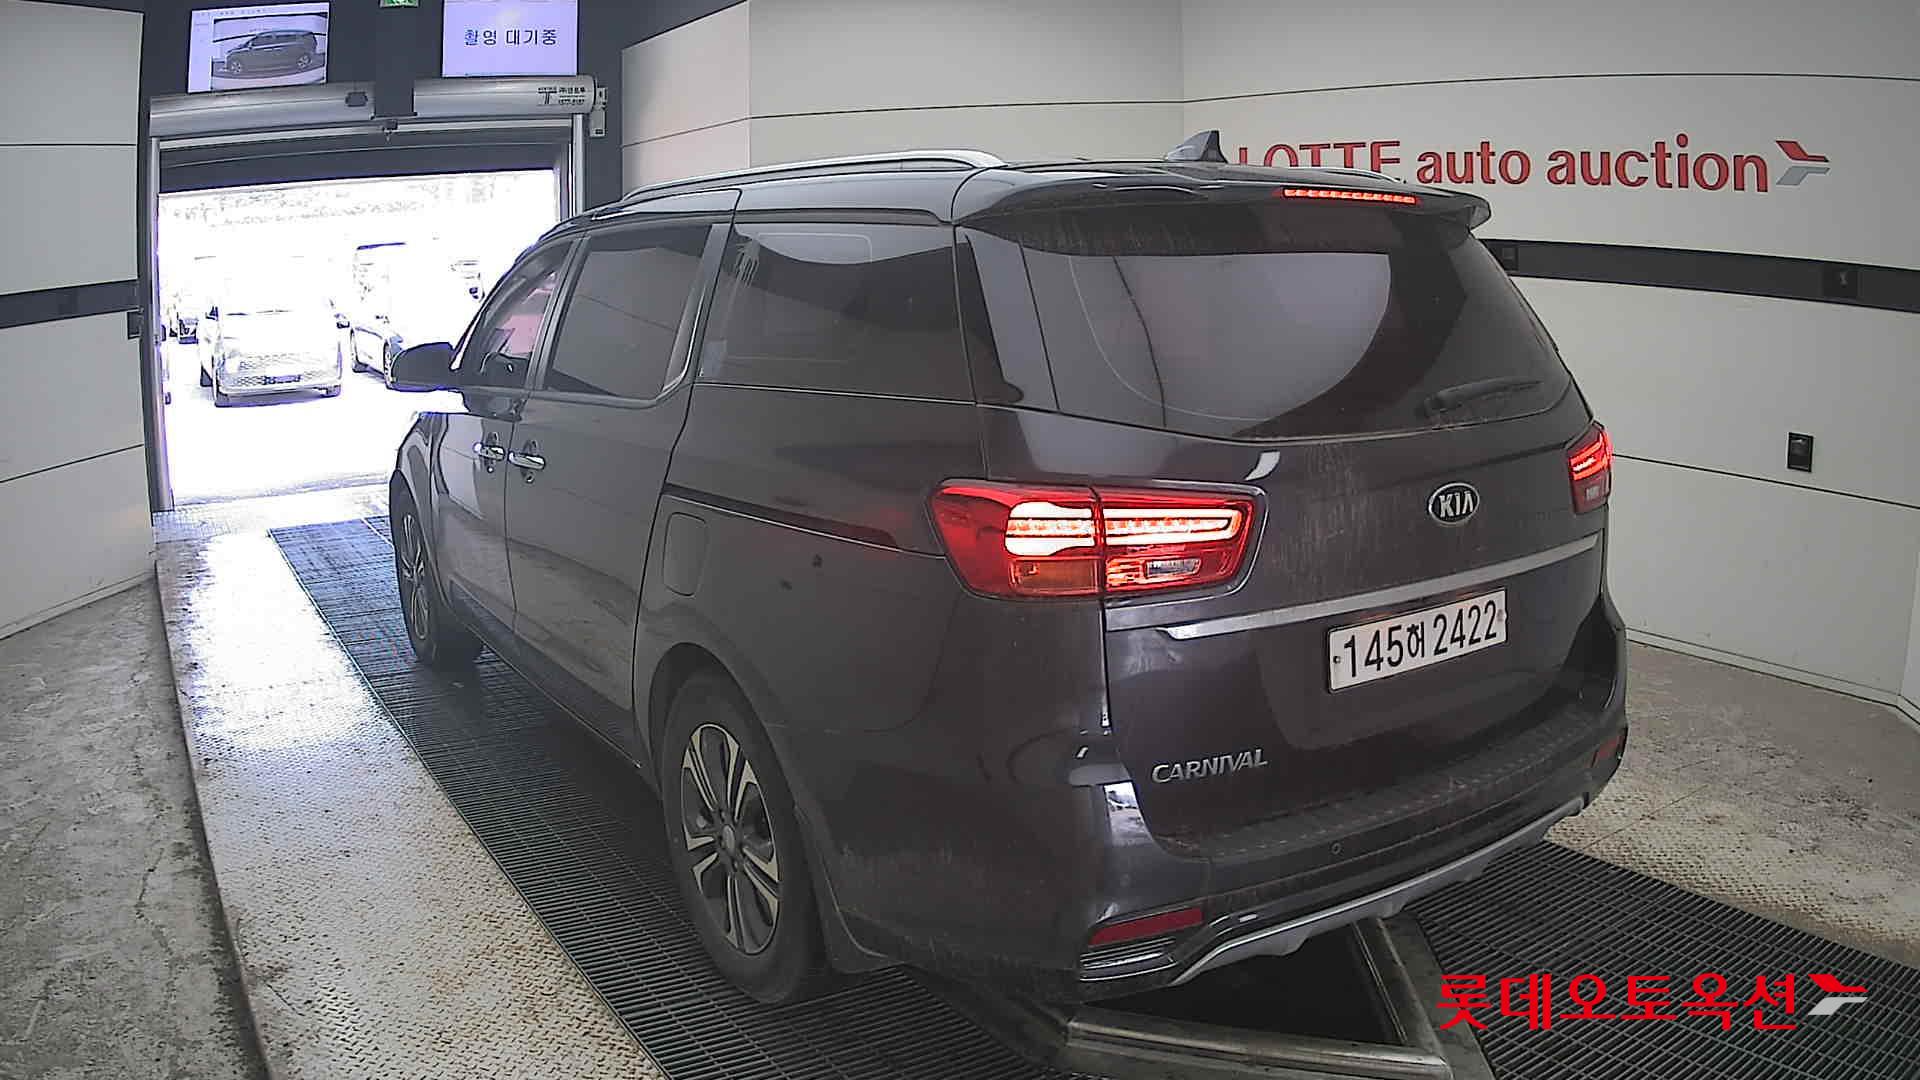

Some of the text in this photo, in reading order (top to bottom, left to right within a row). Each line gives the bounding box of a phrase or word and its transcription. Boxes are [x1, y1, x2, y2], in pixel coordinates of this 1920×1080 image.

[506, 29, 557, 46] 대기중
[1416, 140, 1530, 185] auto
[1546, 133, 1768, 192] auction
[1439, 490, 1474, 518] KIA
[1433, 600, 1497, 656] 2422
[1151, 748, 1268, 783] CARNIVAL
